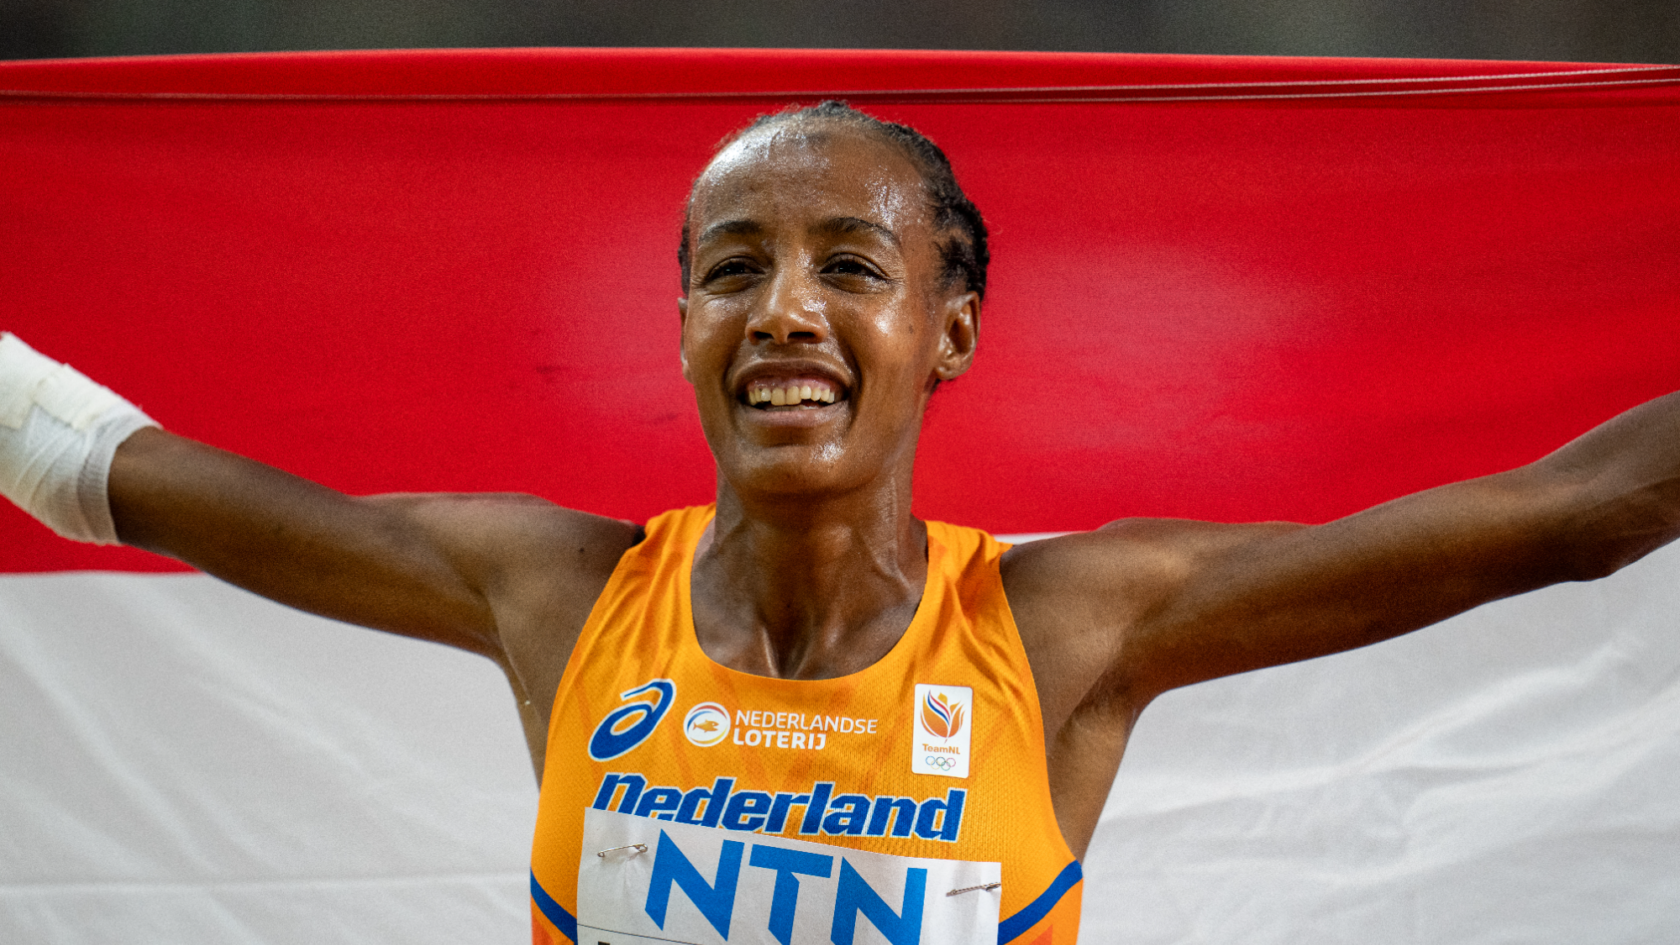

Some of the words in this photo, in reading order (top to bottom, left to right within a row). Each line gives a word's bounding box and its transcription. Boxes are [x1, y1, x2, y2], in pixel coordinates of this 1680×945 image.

[735, 710, 877, 734] NEDERLANDSE
[733, 727, 827, 750] LOTERIJ
[922, 743, 961, 755] TeamNL
[593, 772, 968, 843] nederland
[645, 828, 928, 945] NTN
